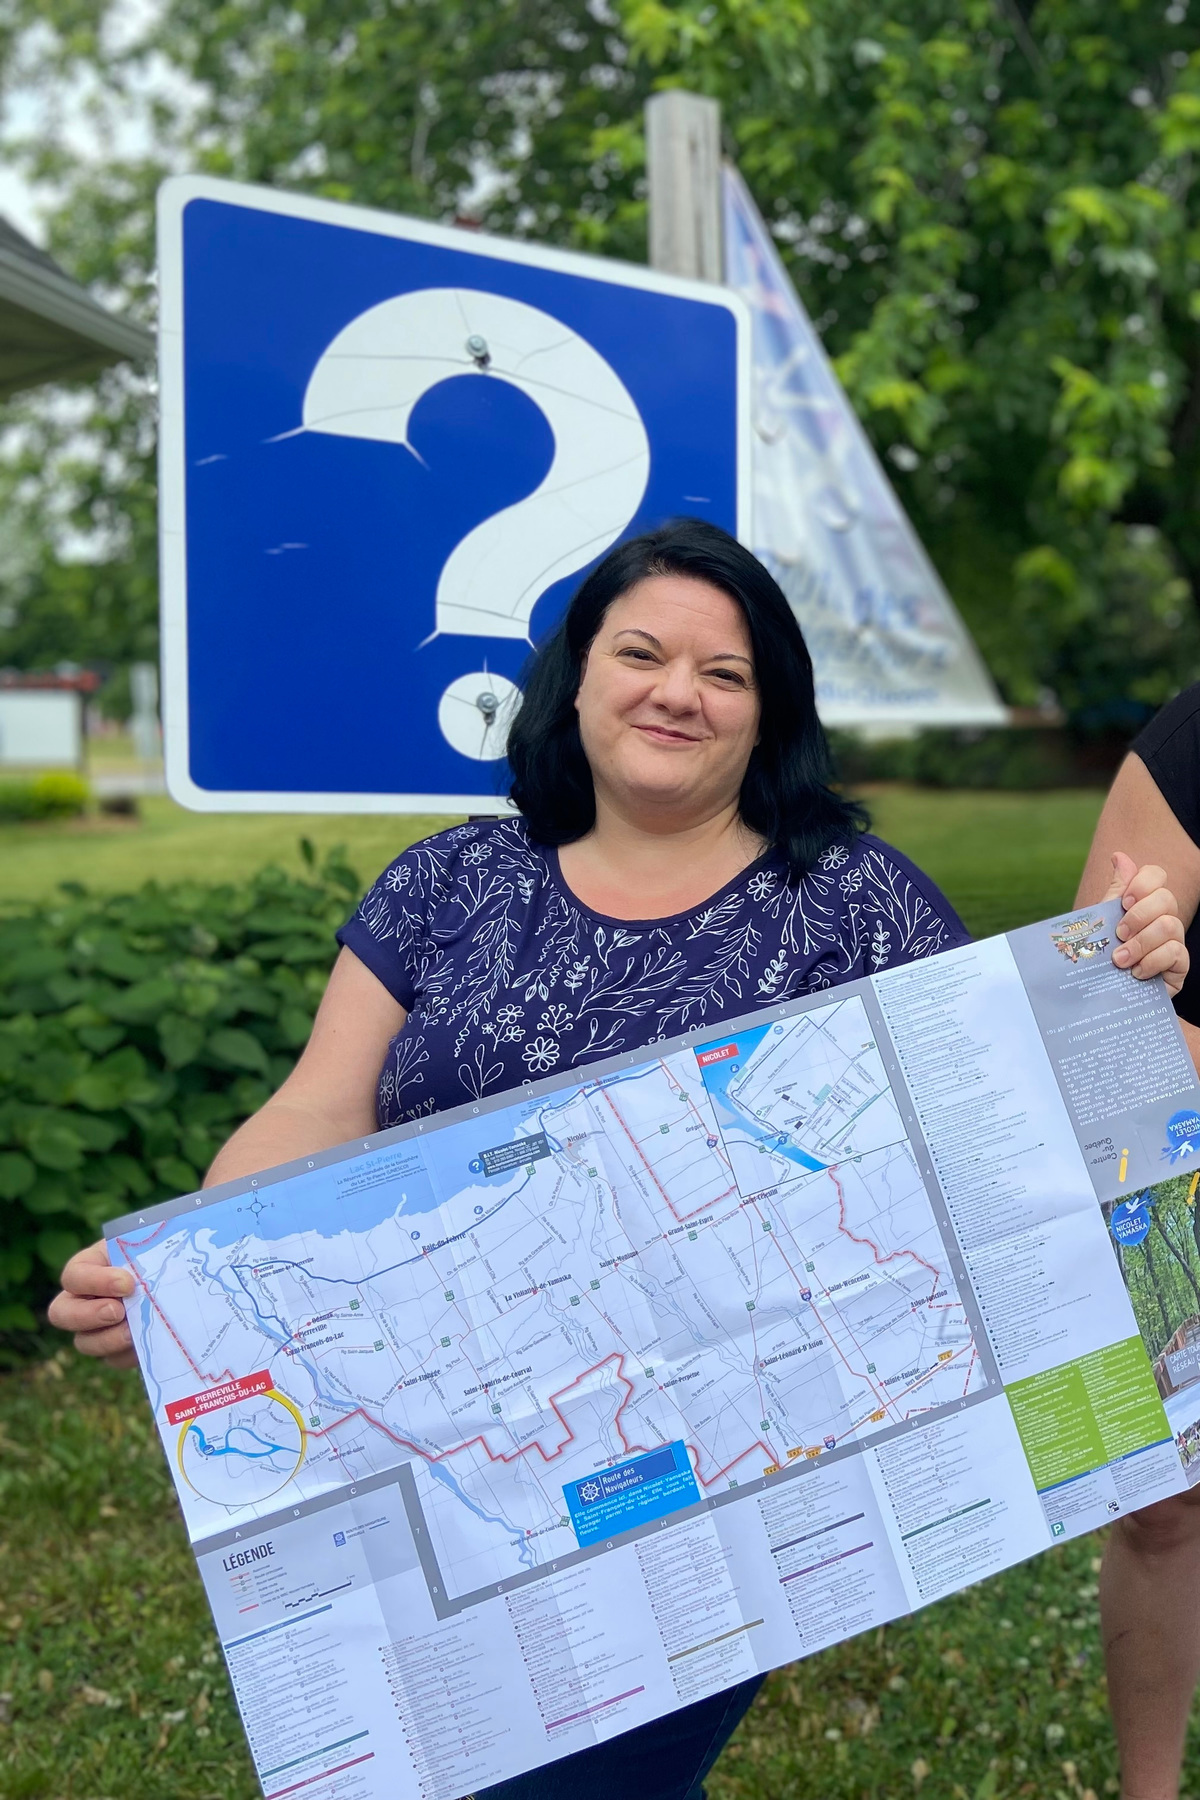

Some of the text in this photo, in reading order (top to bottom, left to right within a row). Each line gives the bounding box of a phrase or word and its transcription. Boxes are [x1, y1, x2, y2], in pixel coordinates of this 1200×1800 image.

[1091, 1011, 1110, 1020] Nicolet
[1132, 1009, 1155, 1022] plaisir
[1156, 1006, 1167, 1014] Un
[1104, 1021, 1121, 1030] vous
[1122, 1017, 1132, 1025] de
[1156, 1016, 1170, 1025] pour
[1071, 1026, 1104, 1042] accueillir
[1119, 1029, 1134, 1037] votre
[1088, 1041, 1116, 1055] multitude
[702, 1048, 730, 1063] NICOLET
[1171, 1071, 1190, 1081] nature
[1159, 1082, 1179, 1092] décors
[1074, 1100, 1104, 1114] succulents
[1105, 1106, 1127, 1118] pédaler
[1076, 1111, 1093, 1120] d'une
[1079, 1116, 1098, 1126] travers
[1168, 1116, 1200, 1132] YAMASKA
[567, 1132, 588, 1144] Nicolet
[1084, 1137, 1112, 1150] Québec
[1102, 1144, 1115, 1152] du-
[349, 1151, 402, 1173] Lac St-Pierre
[1090, 1153, 1118, 1165] Centre-
[386, 1164, 409, 1175] (UNESCO)
[343, 1173, 361, 1182] Réserve
[667, 1215, 713, 1236] Grand-Saint-Esprit
[1115, 1217, 1141, 1232] NICOLET
[1118, 1223, 1148, 1239] YAMASKA
[827, 1272, 870, 1292] Saint-Wenceslas
[298, 1323, 328, 1338] Pierreville
[764, 1339, 824, 1367] Saint-Léonard-D'Aston
[1169, 1350, 1188, 1364] CARTE
[1172, 1356, 1196, 1374] RÉSEAU
[403, 1369, 441, 1388] Saint-Elphège
[663, 1371, 700, 1389] Sainte-Perpétue
[194, 1382, 241, 1403] PIERREVILLE
[175, 1382, 267, 1421] SAINT-FRANÇOIS-DU-LAC
[601, 1466, 634, 1484] Route des
[604, 1473, 643, 1494] Navigateurs
[651, 1486, 662, 1494] Elle
[665, 1480, 679, 1488] vous
[682, 1474, 692, 1482] fait
[574, 1510, 585, 1518] Elle
[586, 1498, 617, 1513] commence
[642, 1468, 691, 1491] Nicolet-Yamaska
[577, 1517, 601, 1530] voyager
[604, 1509, 622, 1520] parmi
[637, 1494, 659, 1507] régions
[662, 1483, 685, 1496] bordant
[222, 1541, 276, 1572] LÉGENDE
